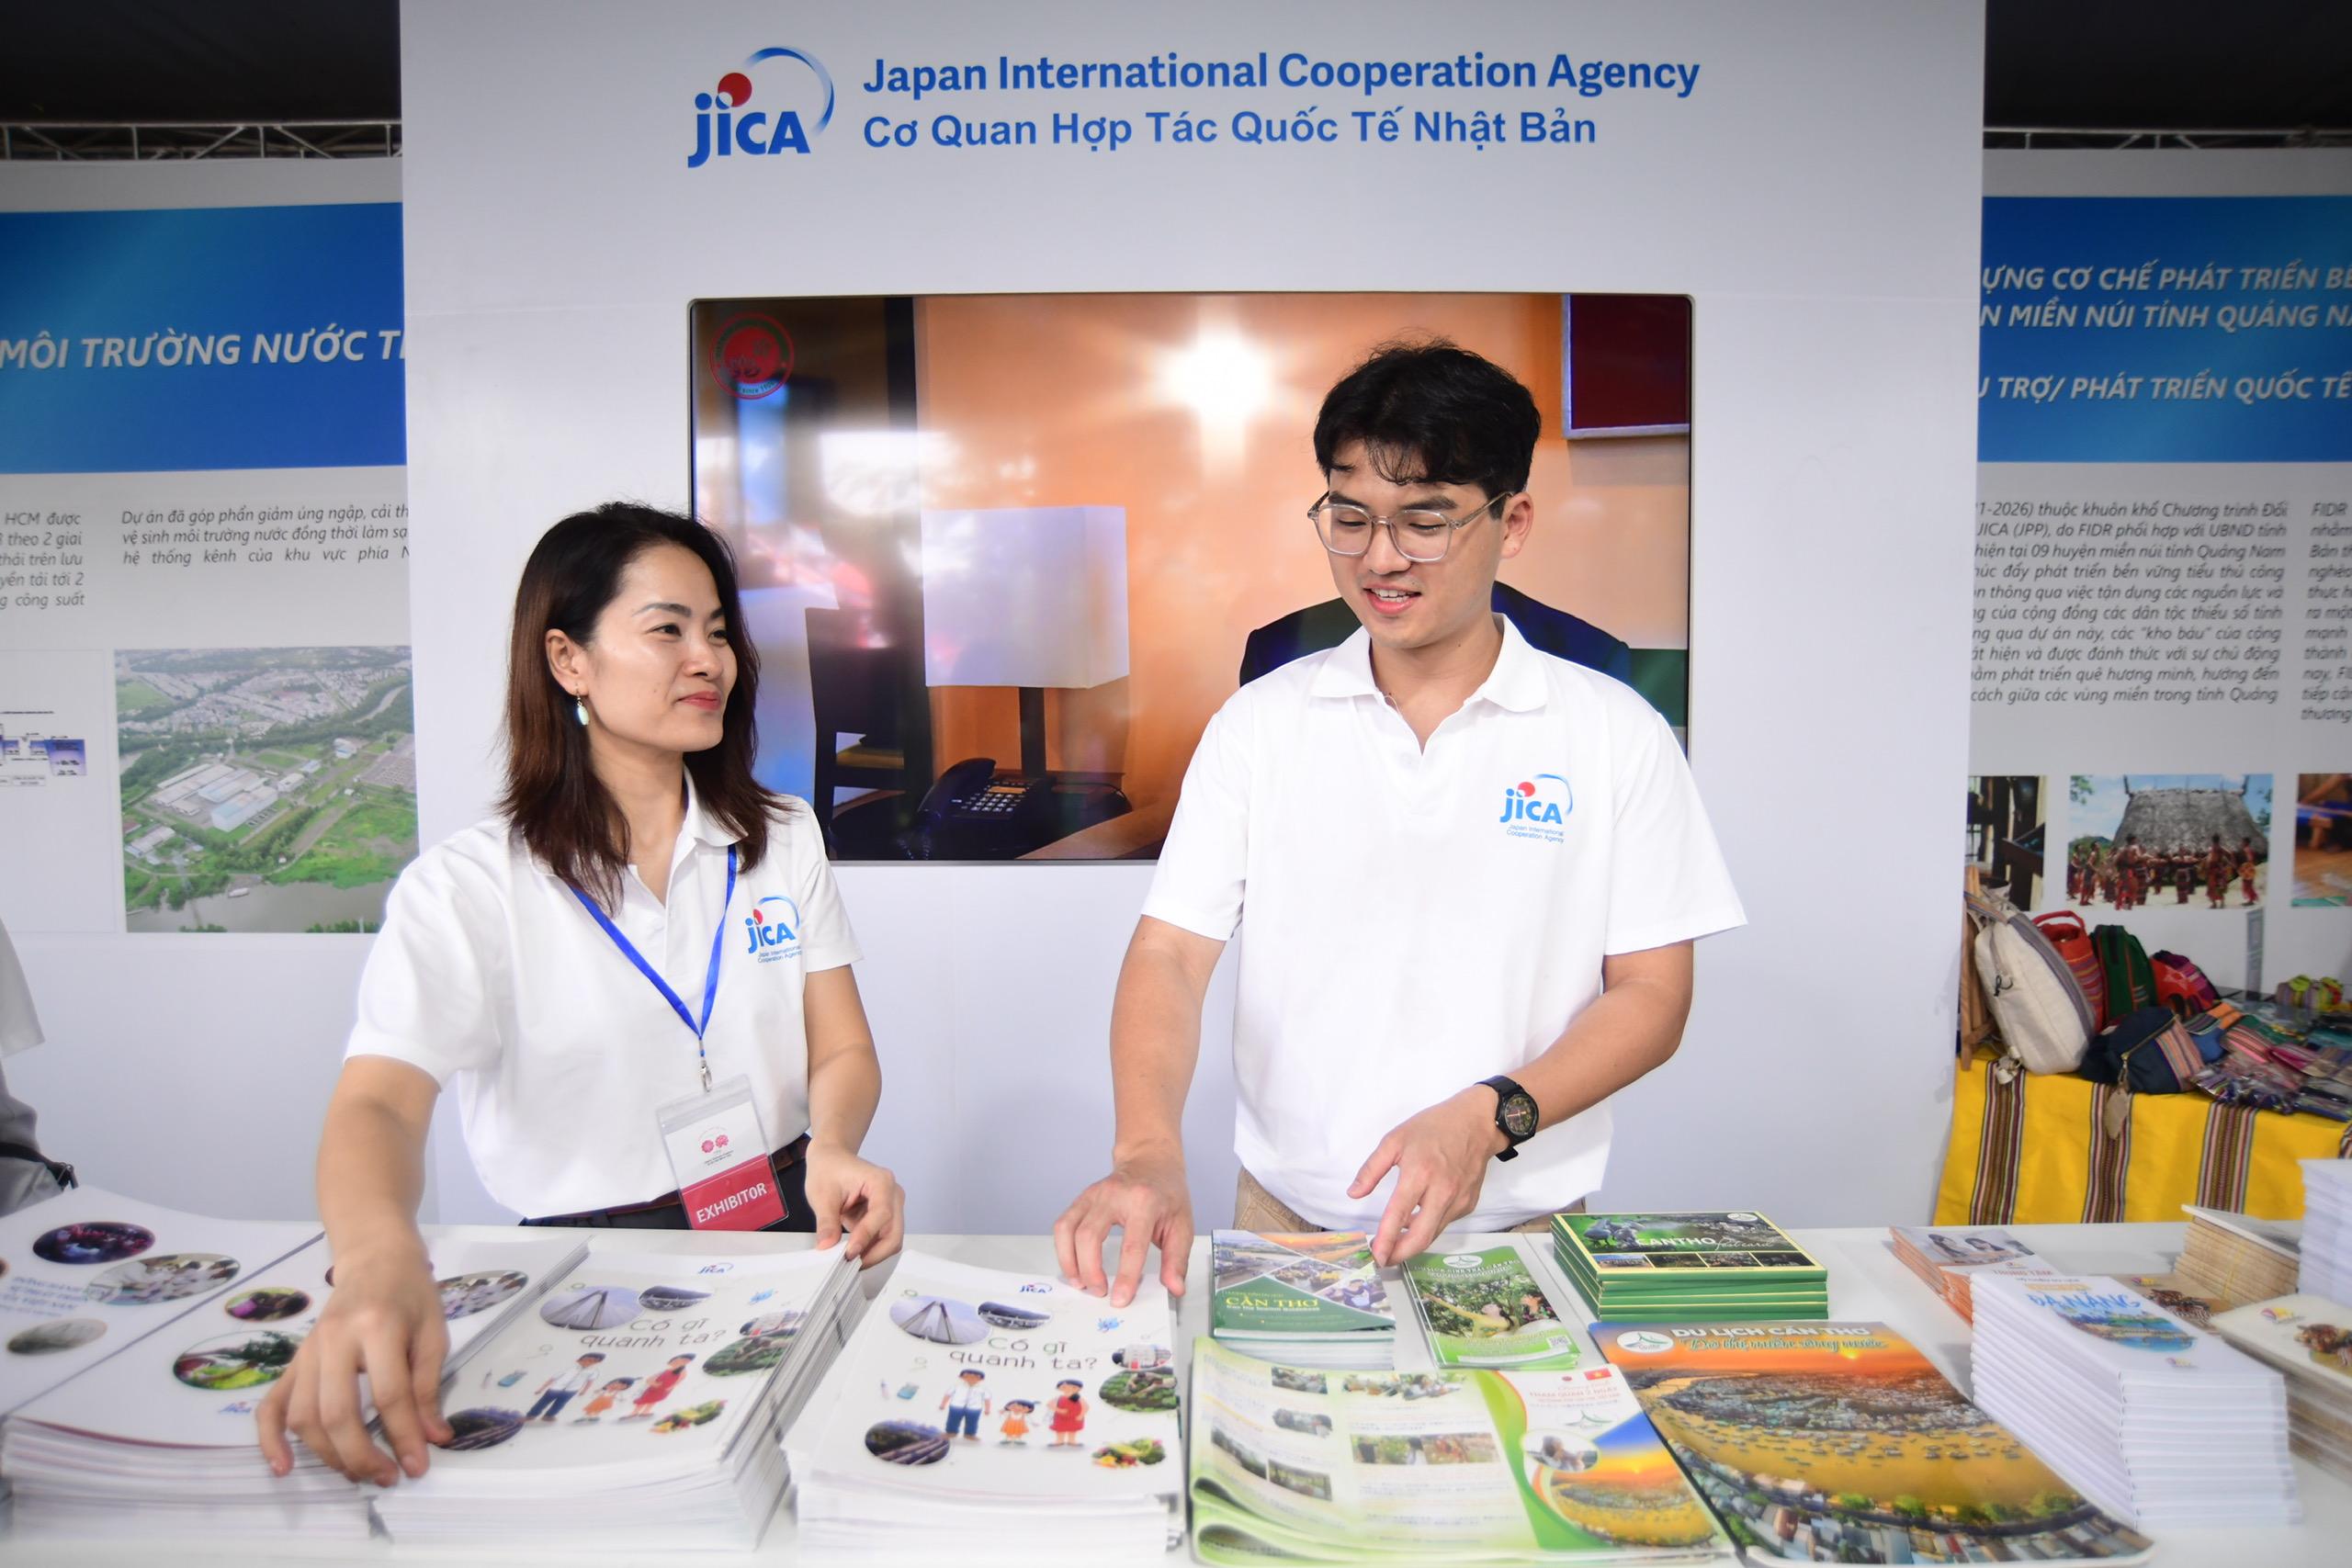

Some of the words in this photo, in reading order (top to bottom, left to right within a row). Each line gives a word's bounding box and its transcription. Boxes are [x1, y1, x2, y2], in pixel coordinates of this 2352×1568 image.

[864, 58, 987, 100] Japan
[1000, 52, 1268, 90] International
[1279, 52, 1536, 96] Cooperation
[1547, 53, 1701, 98] Agency
[864, 116, 918, 148] Cơ
[932, 115, 1036, 149] Quan
[1053, 113, 1132, 152] Hợp
[1146, 110, 1217, 143] Tác
[1231, 106, 1339, 145] Quốc
[1351, 106, 1405, 142] Tế
[1415, 110, 1506, 151] Nhật
[1521, 107, 1596, 143] Bản
[2052, 266, 2094, 290] CƠ
[2098, 258, 2159, 290] CHẾ
[2158, 261, 2233, 290] PHÁT
[2008, 296, 2077, 328] MIỀN
[2084, 299, 2135, 328] NÚI
[2143, 299, 2210, 328] TỈNH
[2217, 299, 2319, 333] QUẢNG
[0, 331, 69, 369] MÔI
[81, 327, 242, 367] TRƯỜNG
[252, 323, 368, 364] NƯỚC
[2070, 371, 2143, 400] PHÁT
[2150, 368, 2226, 400] TRIỂN
[2233, 368, 2314, 404] QUỐC
[5, 512, 40, 525] HCM
[47, 512, 82, 526] được
[121, 511, 142, 526] Dự
[146, 510, 164, 524] án
[168, 509, 185, 524] đã
[189, 508, 215, 526] góp
[219, 505, 254, 525] phần
[258, 505, 293, 525] giảm
[298, 505, 323, 524] úng
[329, 504, 367, 524] ngập,
[371, 503, 390, 519] cải
[7, 532, 39, 547] theo
[43, 533, 52, 546] 2
[56, 531, 83, 549] giai
[122, 531, 138, 545] vệ
[141, 529, 169, 545] sinh
[174, 529, 200, 543] môi
[204, 527, 250, 546] trường
[254, 525, 288, 541] nước
[292, 525, 326, 544] đồng
[331, 525, 358, 539] thời
[362, 525, 389, 539] làm
[1976, 523, 2008, 536] JICA
[2055, 523, 2075, 536] do
[2078, 523, 2113, 536] FIDR
[2115, 522, 2147, 539] phối
[2151, 523, 2179, 540] hợp
[2183, 523, 2205, 536] với
[2209, 523, 2255, 536] UBND
[29, 552, 56, 566] trên
[61, 552, 83, 566] lưu
[123, 550, 141, 567] hệ
[152, 547, 192, 567] thống
[204, 549, 236, 563] kênh
[248, 547, 273, 562] của
[285, 547, 311, 561] khu
[323, 548, 347, 563] vực
[358, 546, 390, 563] phía
[29, 571, 48, 586] tải
[52, 571, 71, 586] tới
[74, 571, 85, 586] 2
[2034, 564, 2068, 581] phát
[2074, 561, 2106, 578] triển
[2112, 562, 2139, 578] bền
[2145, 565, 2180, 582] vững
[16, 592, 49, 610] công
[56, 591, 85, 606] suất
[1996, 628, 2023, 642] qua
[2029, 626, 2049, 642] dự
[2052, 626, 2071, 640] án
[2076, 626, 2105, 643] này,
[2110, 626, 2134, 640] các
[1989, 645, 2019, 662] hiện
[2026, 646, 2042, 660] và
[2047, 646, 2082, 662] được
[2087, 646, 2124, 660] đánh
[2129, 646, 2160, 660] thức
[1971, 687, 2003, 702] cách
[2007, 688, 2040, 705] giữa
[2044, 687, 2068, 702] các
[2074, 688, 2109, 705] vùng
[2113, 685, 2148, 702] miền
[2154, 689, 2191, 705] trong
[1507, 829, 1543, 840] Cooperation
[1544, 834, 1564, 844] Agency
[1529, 826, 1564, 836] International
[696, 1182, 768, 1224] EXHIBITOR
[1635, 1237, 1716, 1247] CANTHO
[1226, 1294, 1269, 1307] CẦN
[1273, 1298, 1318, 1308] THƠ
[629, 1318, 673, 1332] Có
[682, 1317, 710, 1333] gì
[1670, 1328, 1707, 1337] DU
[1710, 1327, 1765, 1339] LỊCH
[1768, 1325, 1819, 1336] CẦN
[1819, 1326, 1871, 1336] THƠ
[581, 1335, 665, 1348] quanh
[680, 1329, 727, 1346] ta?
[989, 1337, 1029, 1352] Có
[1043, 1341, 1069, 1356] gì
[950, 1350, 1035, 1370] quanh
[1053, 1357, 1098, 1370] ta?
